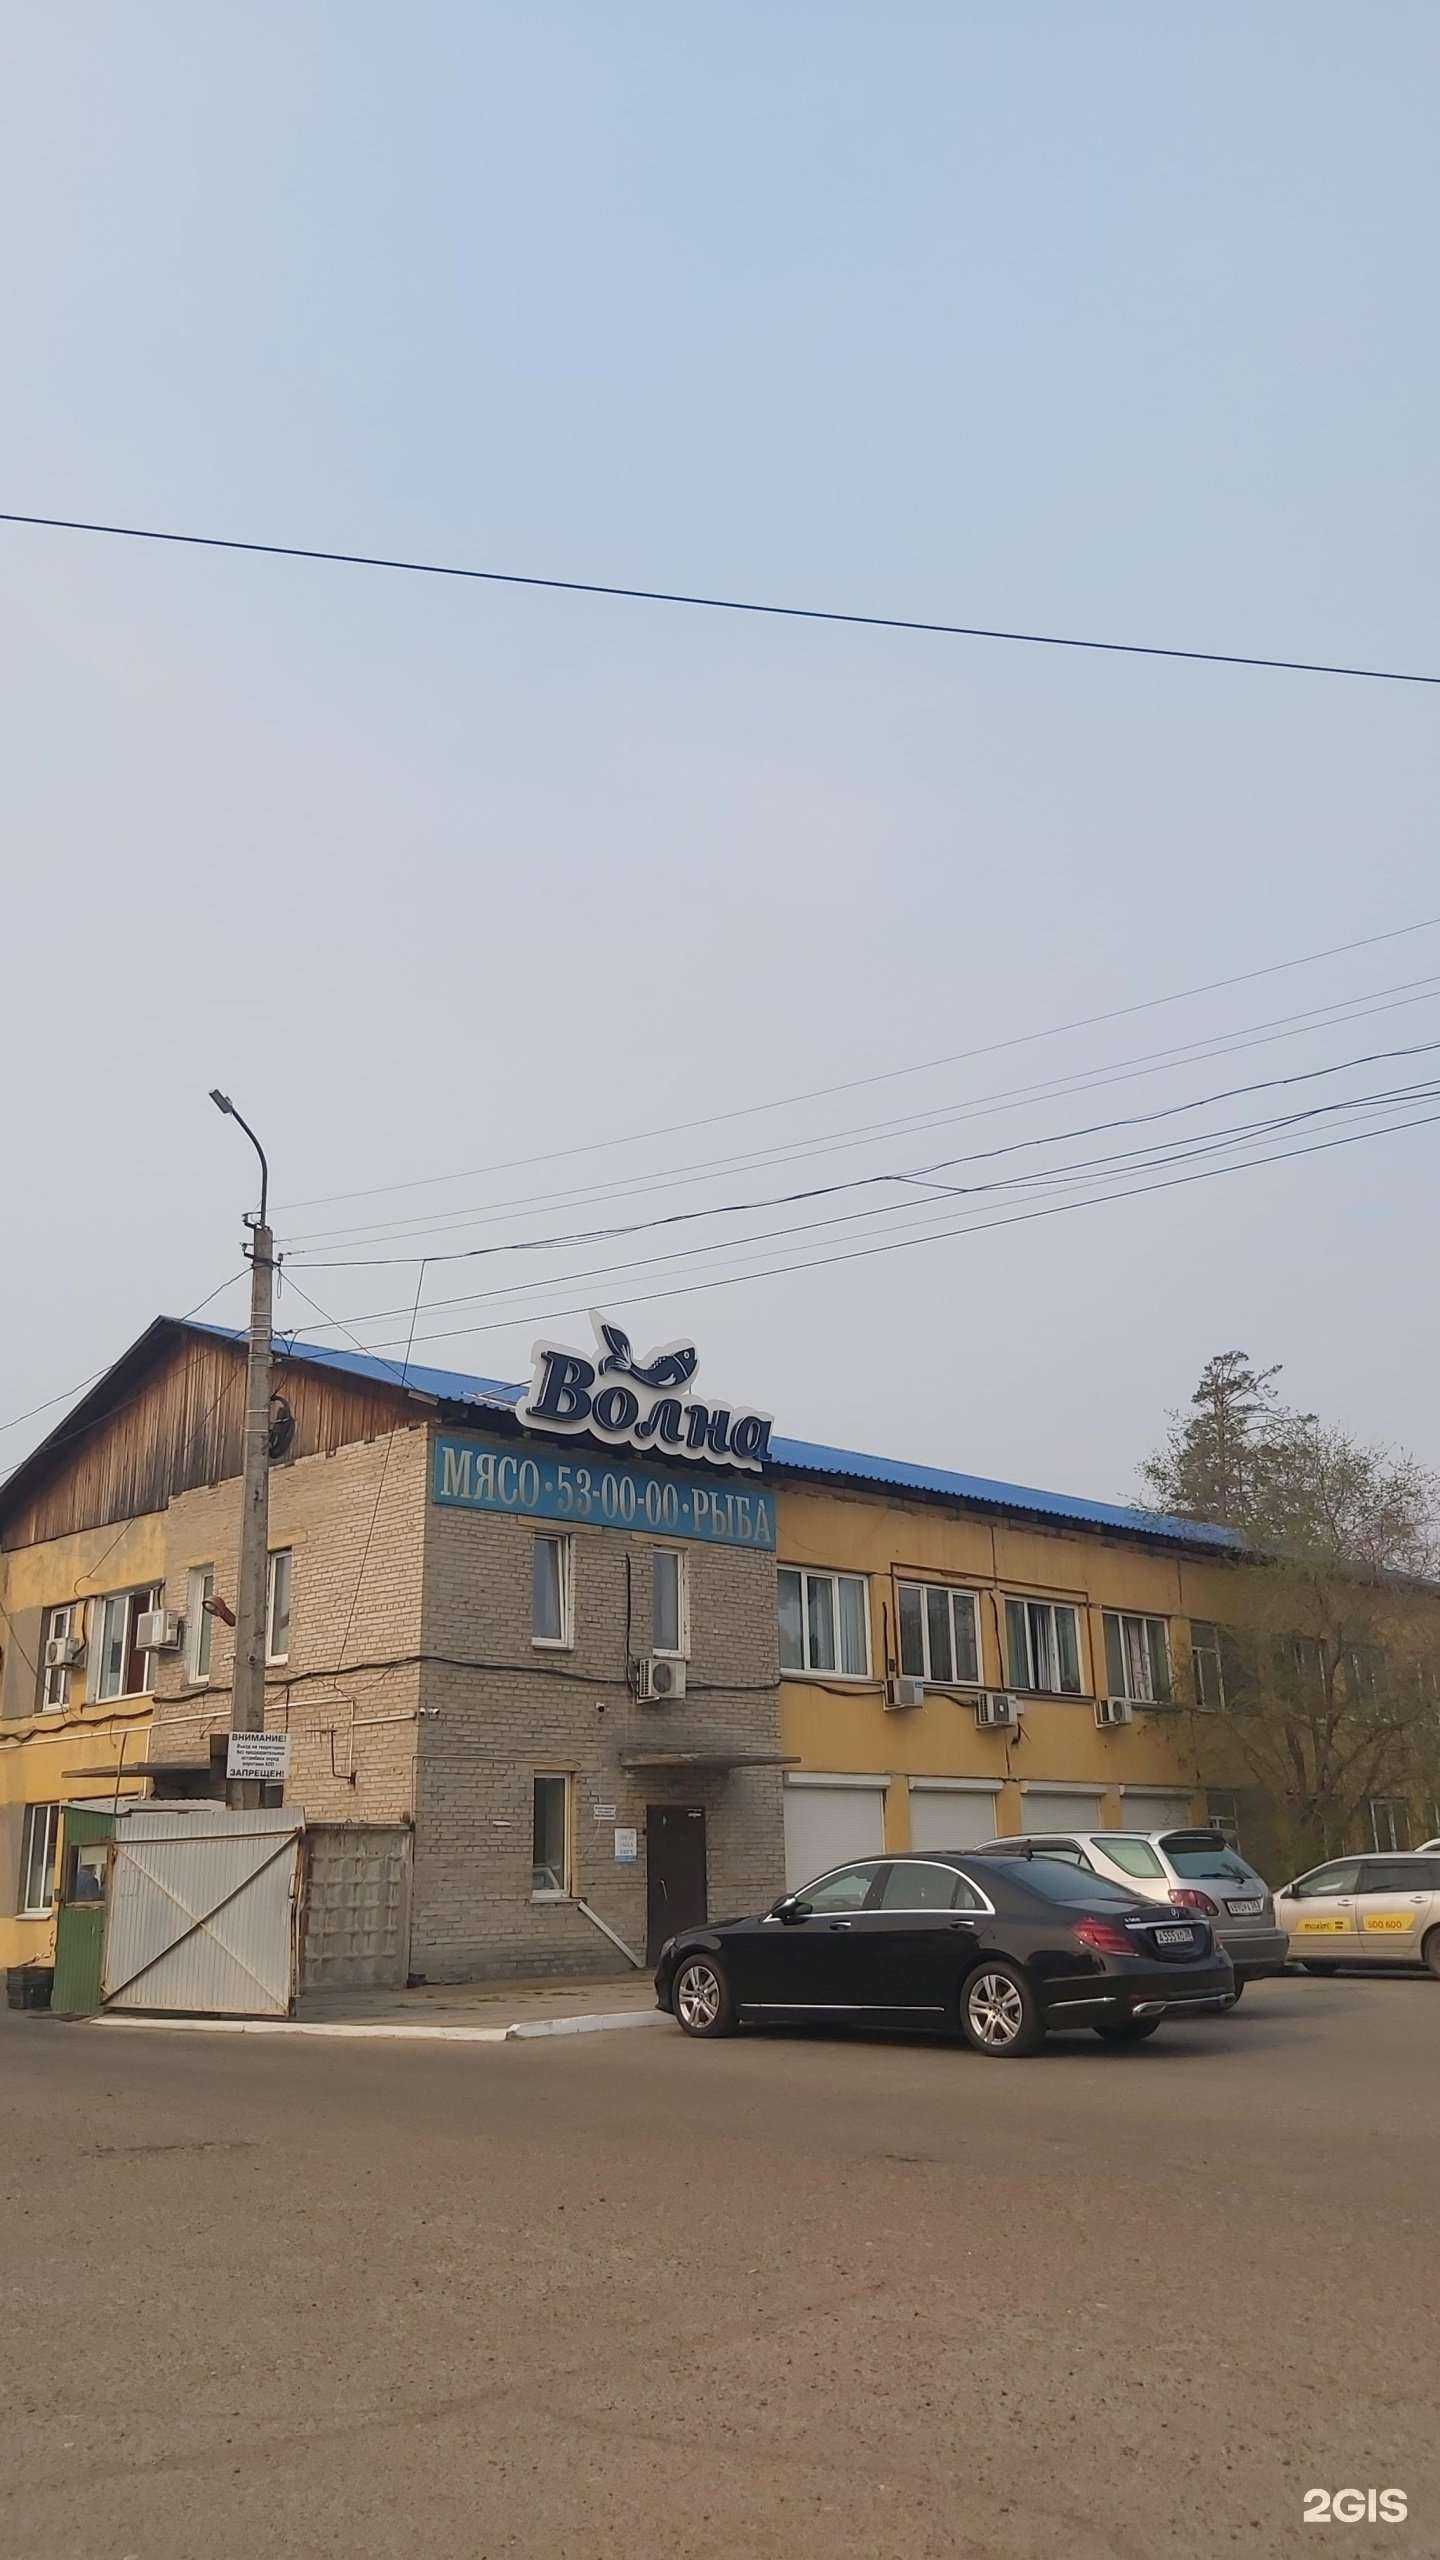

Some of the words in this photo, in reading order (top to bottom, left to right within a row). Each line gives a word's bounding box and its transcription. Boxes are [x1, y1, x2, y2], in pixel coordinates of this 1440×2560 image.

[526, 1350, 774, 1461] Волна
[440, 1447, 540, 1507] МЯСО
[557, 1466, 678, 1527] 53-00-00
[691, 1488, 772, 1542] РЫБА
[232, 1733, 287, 1742] ВНИМАНИЕ!
[230, 1769, 284, 1778] ЗАПРЕЩЕН!
